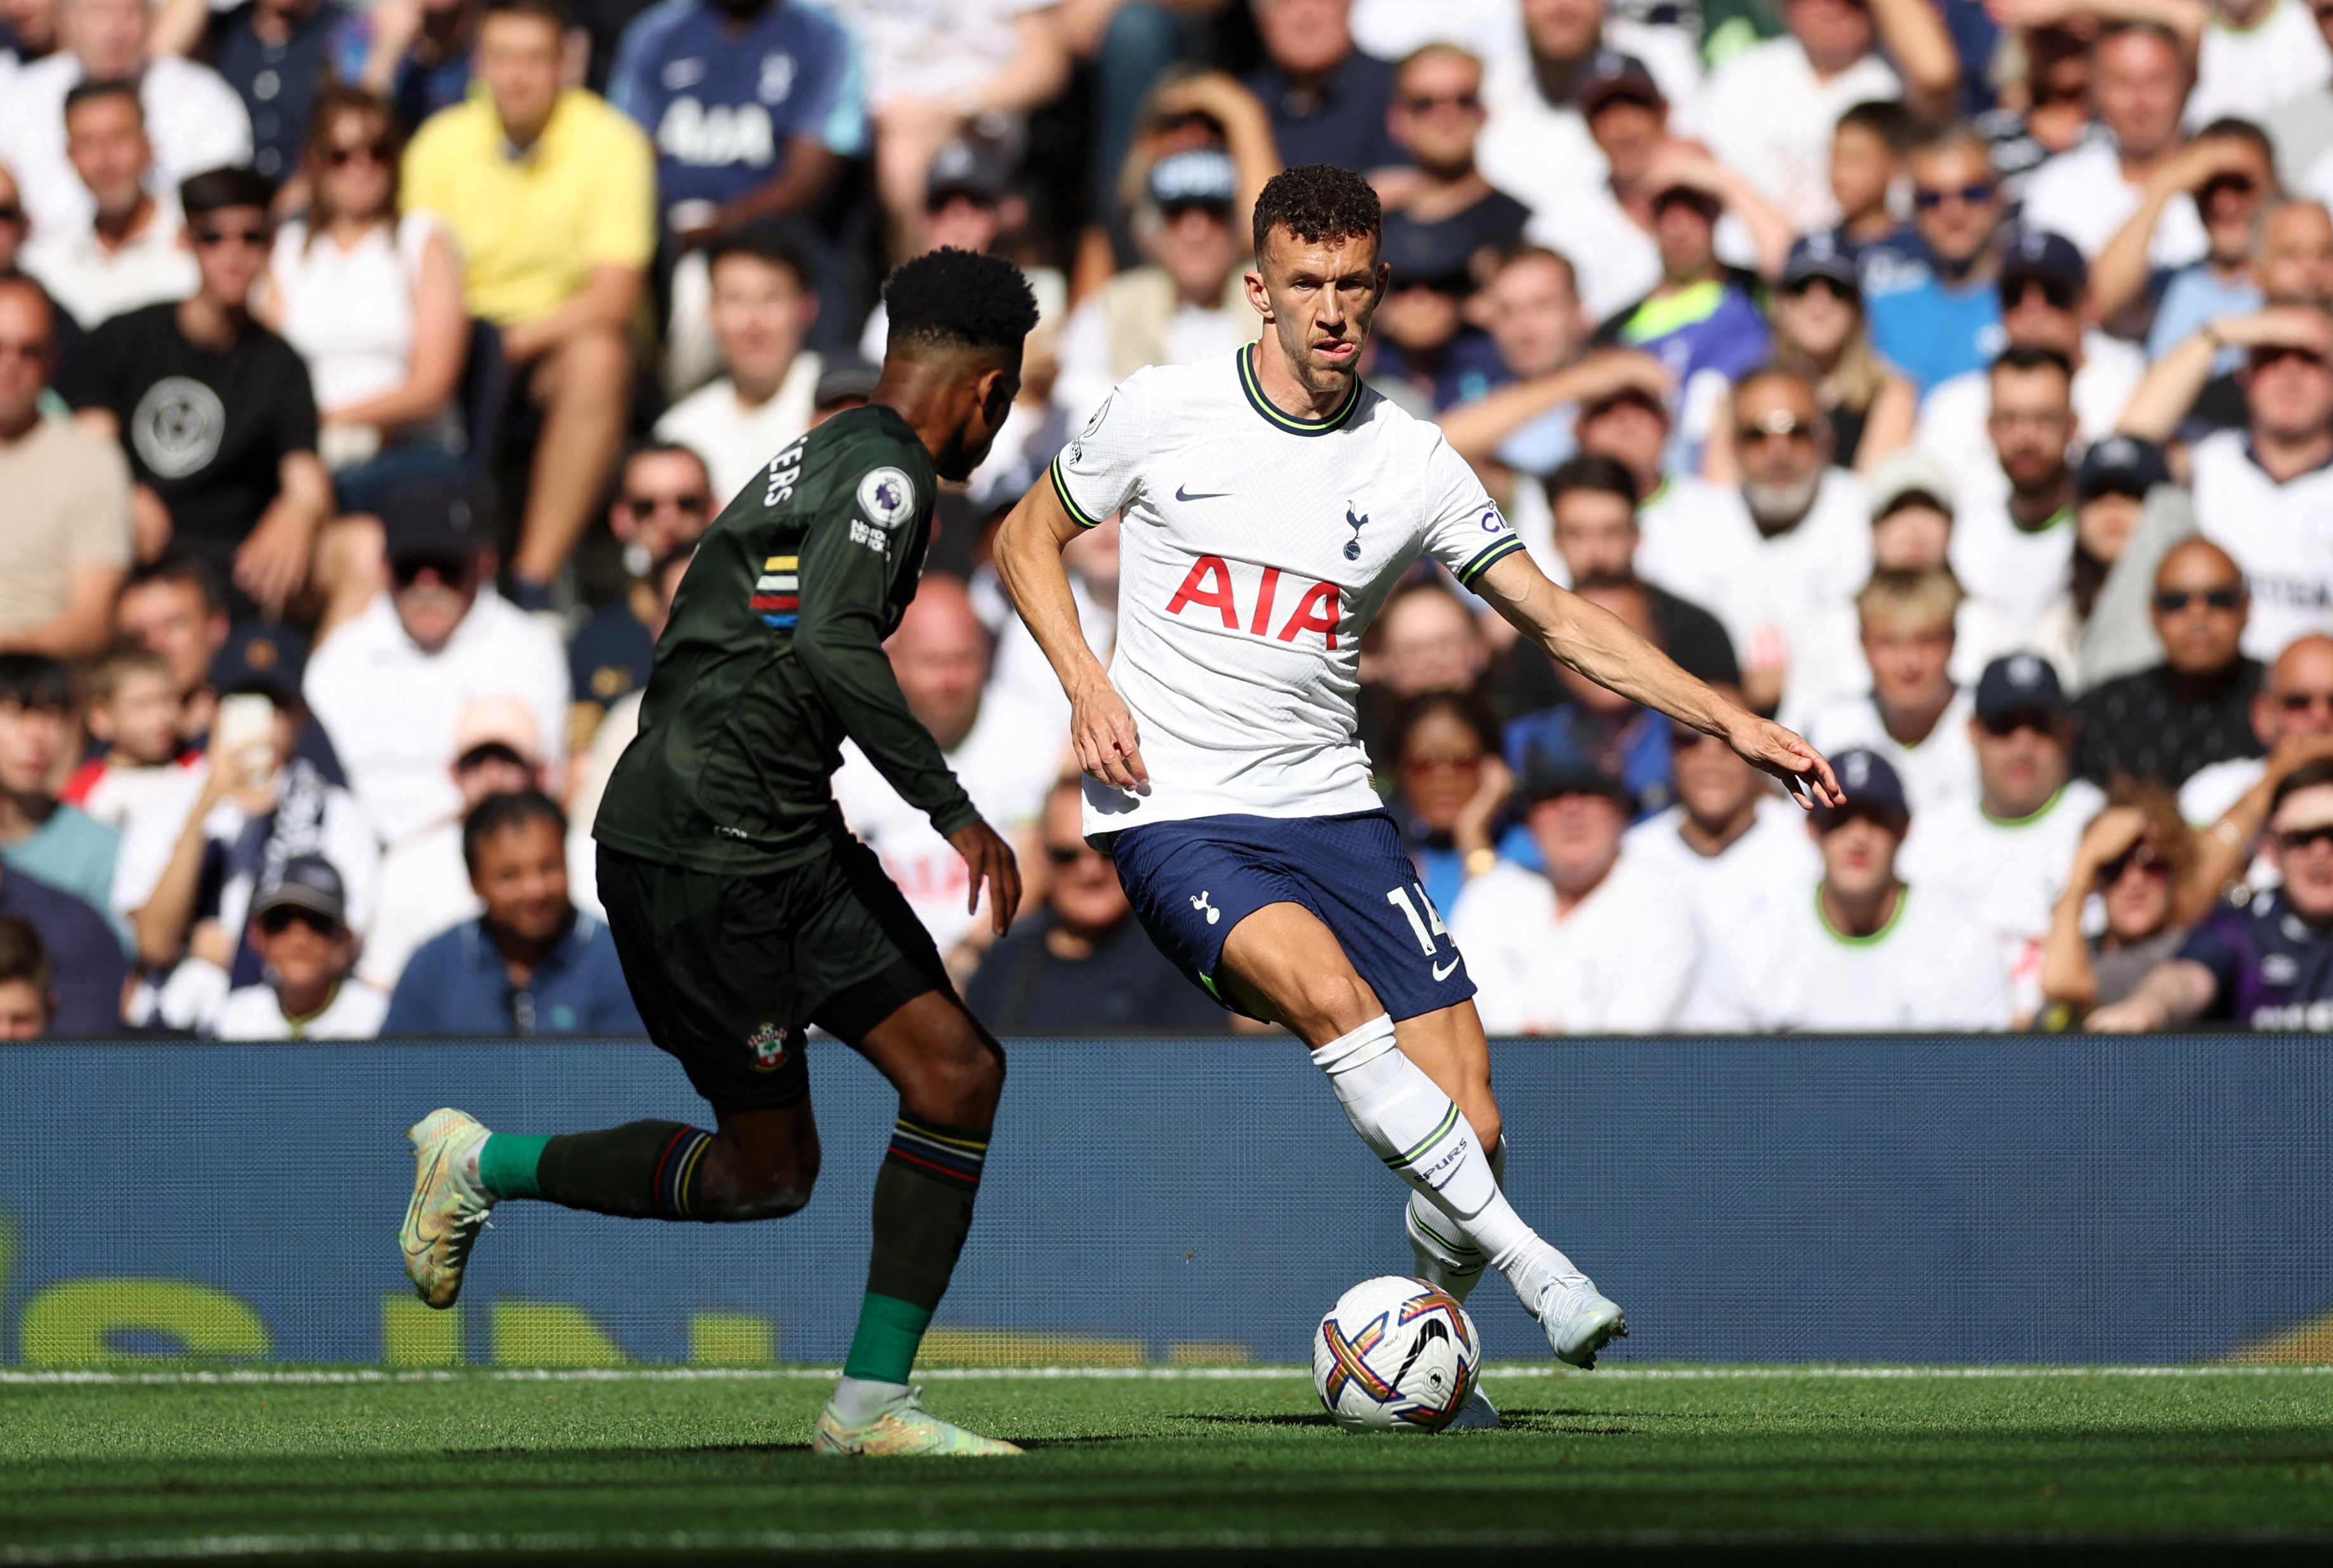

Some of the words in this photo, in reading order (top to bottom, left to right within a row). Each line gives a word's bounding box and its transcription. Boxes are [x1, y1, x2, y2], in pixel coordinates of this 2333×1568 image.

[764, 435, 809, 507] ERS
[1165, 554, 1340, 651] AIA
[1387, 883, 1456, 956] 14
[1414, 1137, 1467, 1182] SPURS
